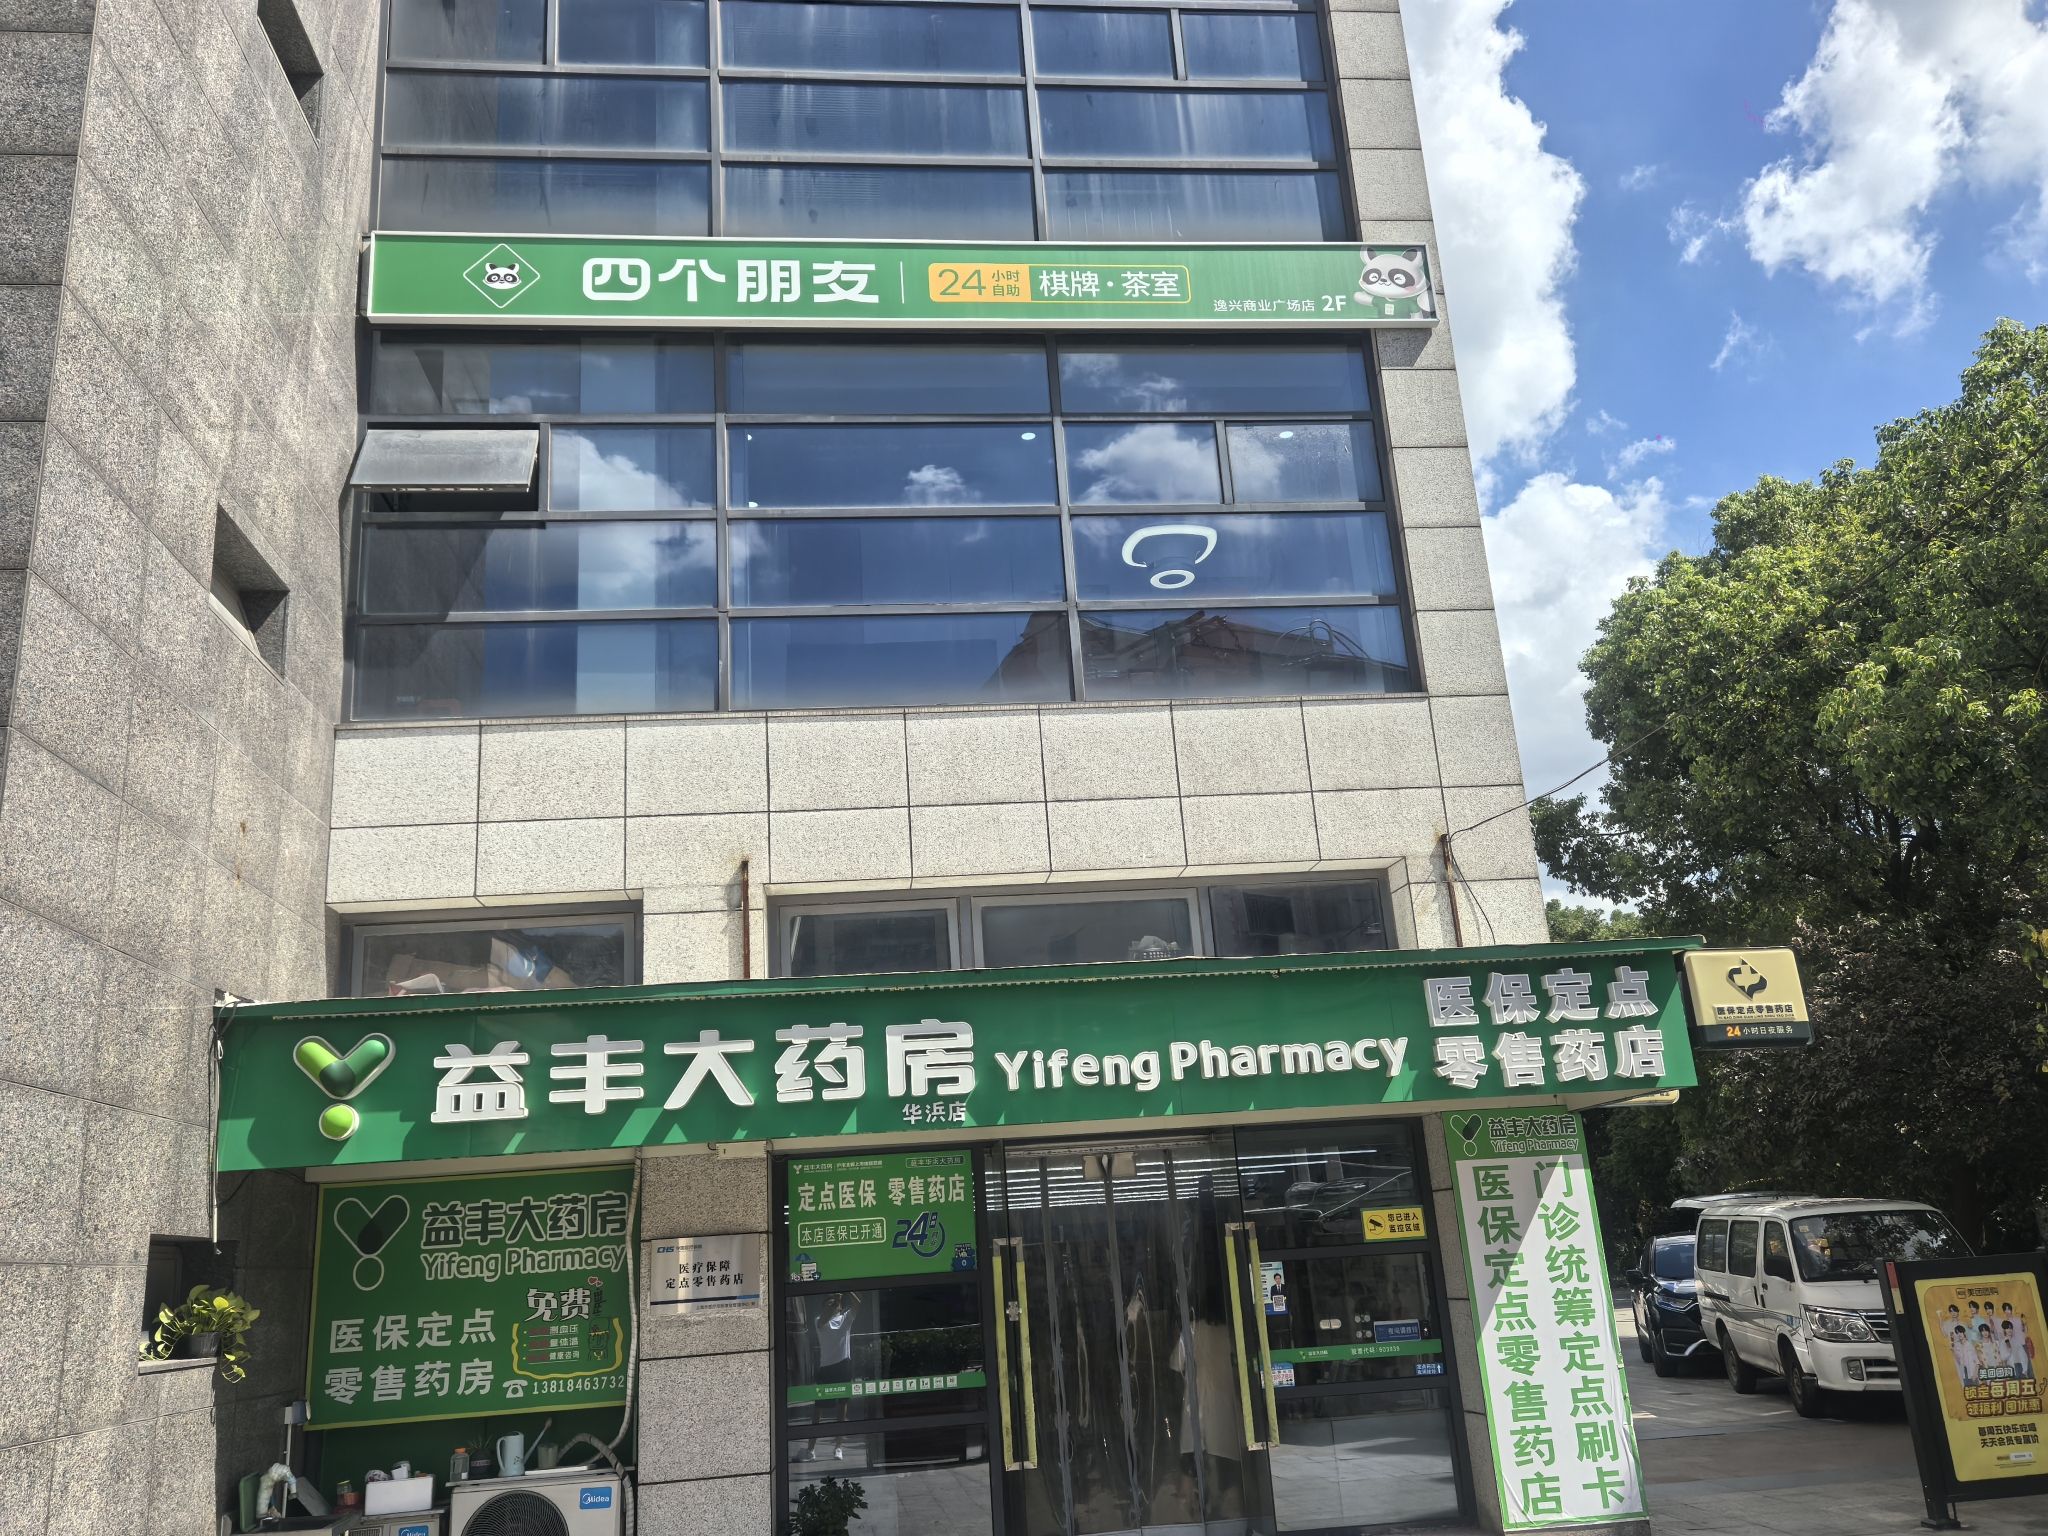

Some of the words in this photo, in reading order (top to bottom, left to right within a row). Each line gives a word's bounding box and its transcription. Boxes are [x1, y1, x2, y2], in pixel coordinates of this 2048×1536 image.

[582, 256, 880, 304] 四个朋友
[936, 267, 988, 297] 24
[991, 269, 1020, 283] 小时
[991, 283, 1020, 298] 自助
[1213, 299, 1317, 313] 逸兴商业广场店
[1322, 294, 1348, 312] 2F
[1423, 966, 1660, 1028] 医保定点
[1716, 1004, 1794, 1016] 医保定点零售药店
[1726, 1025, 1742, 1037] 24
[1743, 1025, 1794, 1036] 小时日夜服务
[431, 1018, 978, 1127] 益丰大药房
[994, 1046, 1162, 1095] Yifeng
[1167, 1035, 1410, 1088] Pharmacy
[1433, 1024, 1668, 1091] 零售药店
[902, 1101, 967, 1125] 华浜店
[1487, 1113, 1578, 1139] 益丰大药房
[1490, 1139, 1526, 1154] Yifeng
[1527, 1136, 1579, 1152] Pharmacy
[798, 1179, 877, 1212] 定点医保
[888, 1173, 966, 1206] 零售药店
[421, 1190, 629, 1250] 益丰大药房
[801, 1222, 883, 1244] 本店医保已开通
[892, 1210, 930, 1248] 24
[421, 1252, 501, 1283] Yifeng
[504, 1244, 628, 1278] Pharmacy
[656, 1245, 675, 1254] CHS
[665, 1273, 744, 1289] 定点零售药店
[679, 1260, 731, 1274] 医疗保障
[524, 1287, 592, 1322] 免费
[328, 1308, 497, 1354] 医保定点
[1472, 1164, 1564, 1518] 医保定点零售药店
[1533, 1157, 1627, 1511] 门诊统筹定点刷卡
[323, 1357, 496, 1406] 零售药房
[532, 1375, 625, 1395] 13818463732
